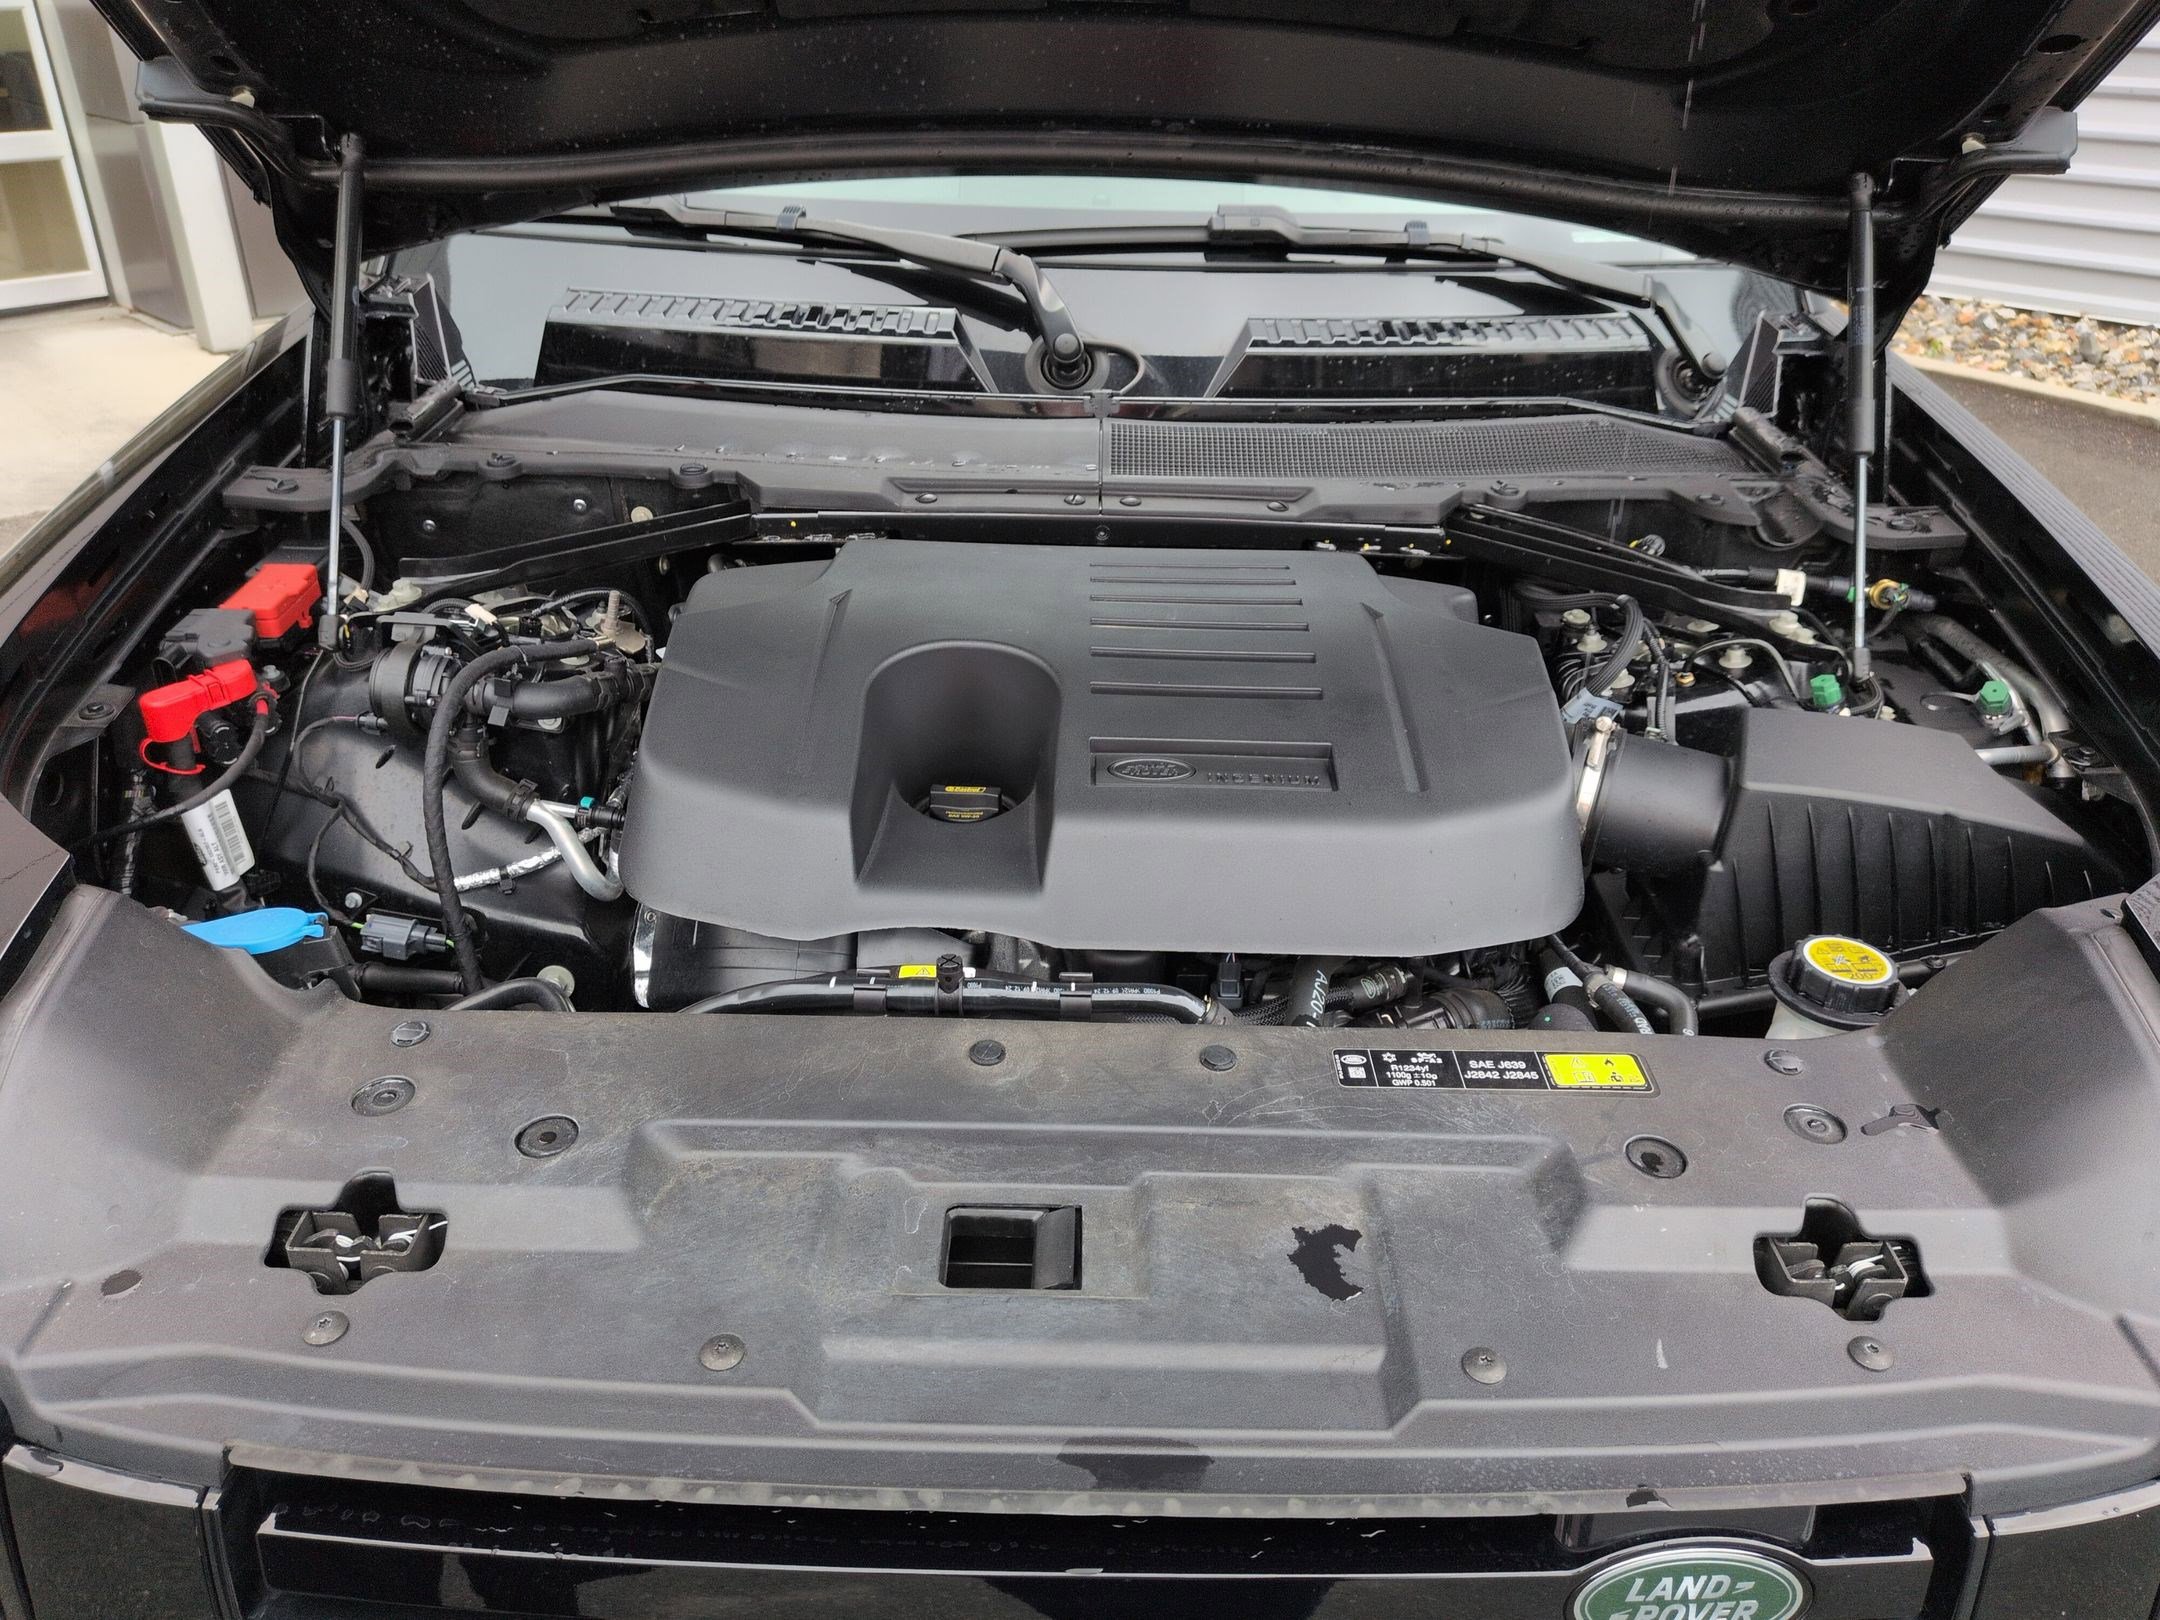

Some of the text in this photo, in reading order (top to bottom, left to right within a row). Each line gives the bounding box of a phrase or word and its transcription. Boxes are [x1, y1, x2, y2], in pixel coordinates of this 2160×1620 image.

[1468, 1060, 1527, 1070] SAE J639
[1464, 1070, 1539, 1080] J2842 J2845
